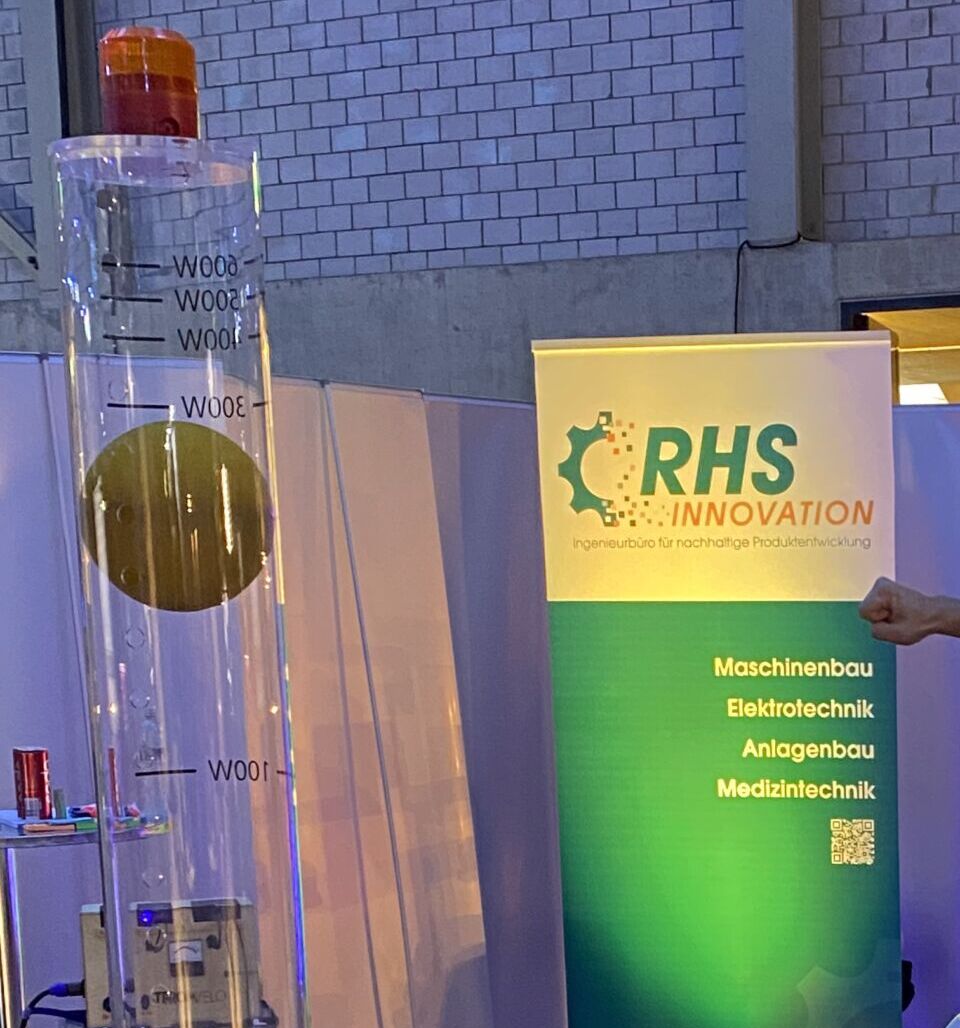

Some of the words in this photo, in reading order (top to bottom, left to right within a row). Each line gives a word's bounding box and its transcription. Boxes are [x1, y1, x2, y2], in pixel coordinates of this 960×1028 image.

[640, 424, 798, 496] RHS
[671, 500, 874, 527] INNOVATION
[573, 537, 656, 550] Ingenieurbüro
[658, 536, 674, 549] für
[677, 536, 750, 550] nachhaltige
[753, 536, 872, 549] Produktentwicklung
[714, 657, 874, 678] Maschinenbau
[727, 698, 874, 719] Elektrotechnik
[742, 738, 875, 762] Anlagenbau
[717, 778, 876, 800] Medizintechnik
